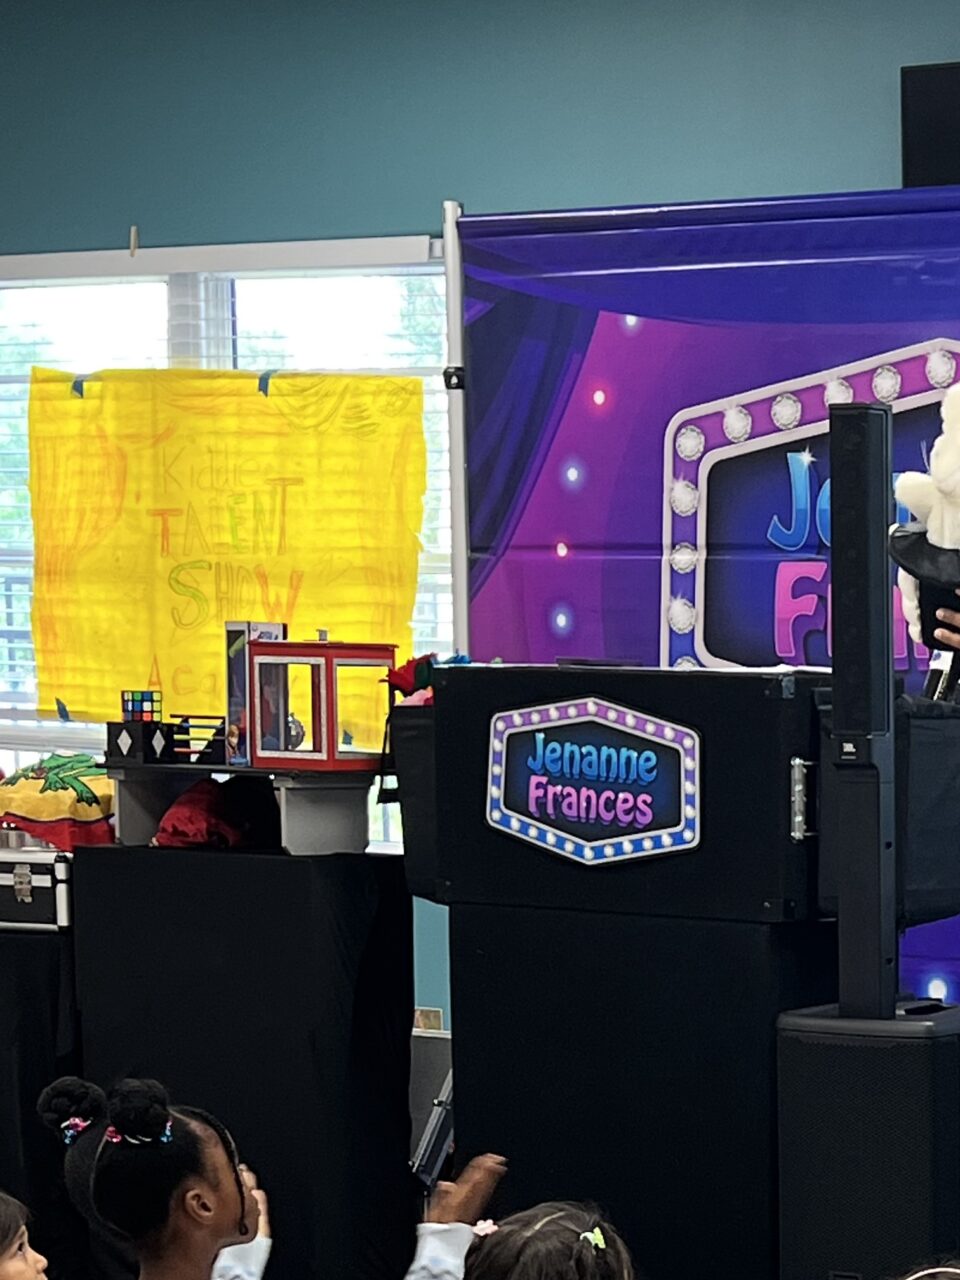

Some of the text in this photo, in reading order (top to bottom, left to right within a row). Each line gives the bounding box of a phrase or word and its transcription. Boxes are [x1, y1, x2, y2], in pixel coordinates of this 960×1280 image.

[146, 477, 304, 557] TALENT
[168, 560, 304, 630] SHOW
[526, 732, 658, 785] Jenanne
[527, 774, 654, 829] Frances
